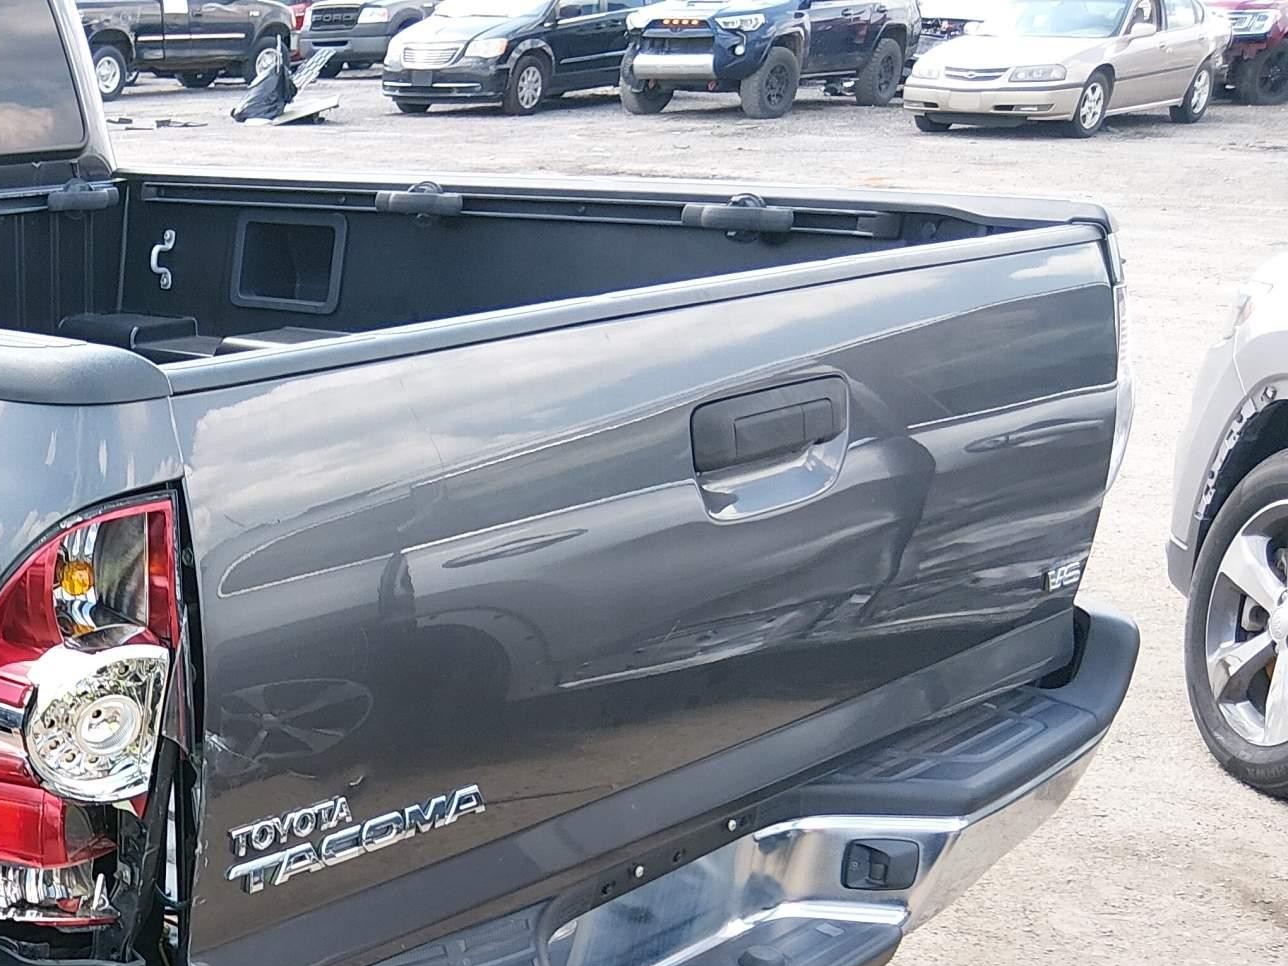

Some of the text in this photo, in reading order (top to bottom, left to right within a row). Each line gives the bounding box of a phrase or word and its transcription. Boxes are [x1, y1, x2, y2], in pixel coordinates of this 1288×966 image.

[312, 13, 355, 23] FORD
[225, 784, 486, 895] TACOMA
[228, 795, 353, 857] TOYOTA
